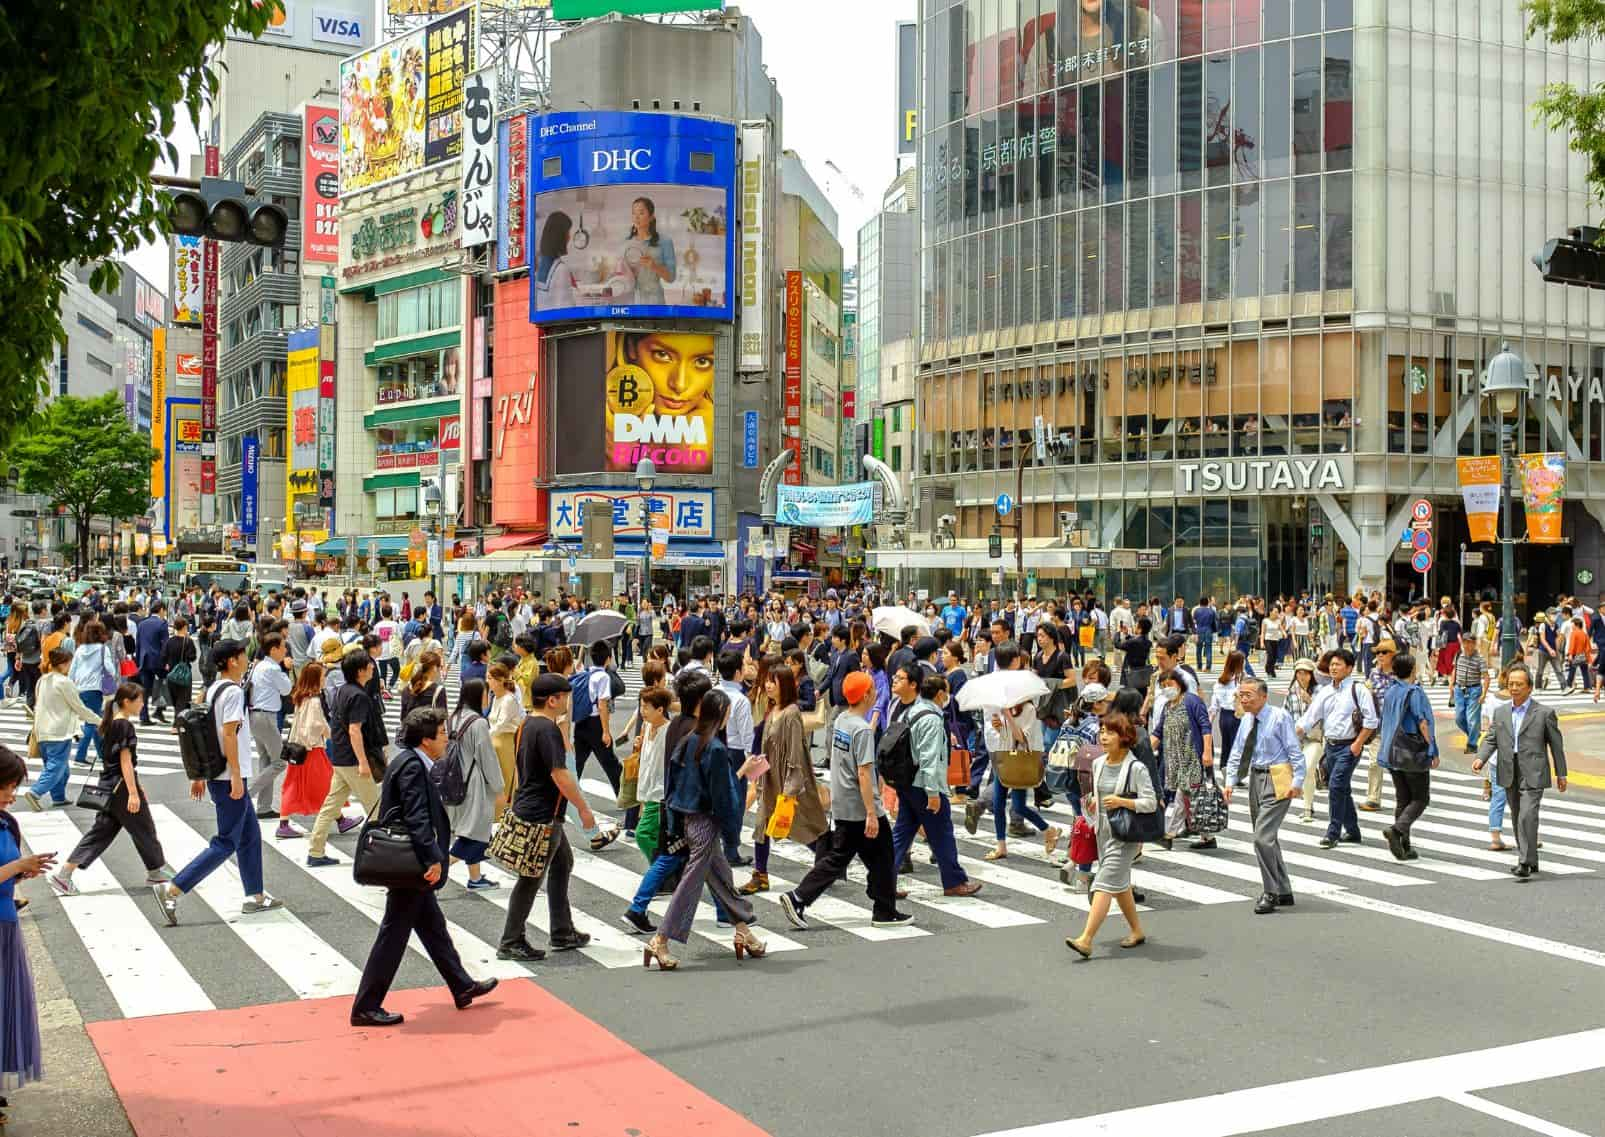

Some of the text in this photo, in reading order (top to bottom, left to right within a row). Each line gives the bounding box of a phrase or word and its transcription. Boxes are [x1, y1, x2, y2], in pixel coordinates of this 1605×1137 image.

[315, 17, 361, 38] VISA
[540, 120, 597, 138] DHC Channel
[464, 74, 494, 238] もんじゃ
[591, 147, 653, 173] DHC
[611, 306, 630, 316] DHC
[1456, 368, 1605, 404] TSTAYA
[613, 412, 708, 445] DMM
[612, 443, 708, 466] Bitcoin
[1179, 459, 1344, 492] TSUTAYA
[556, 498, 705, 529] 大堂店
